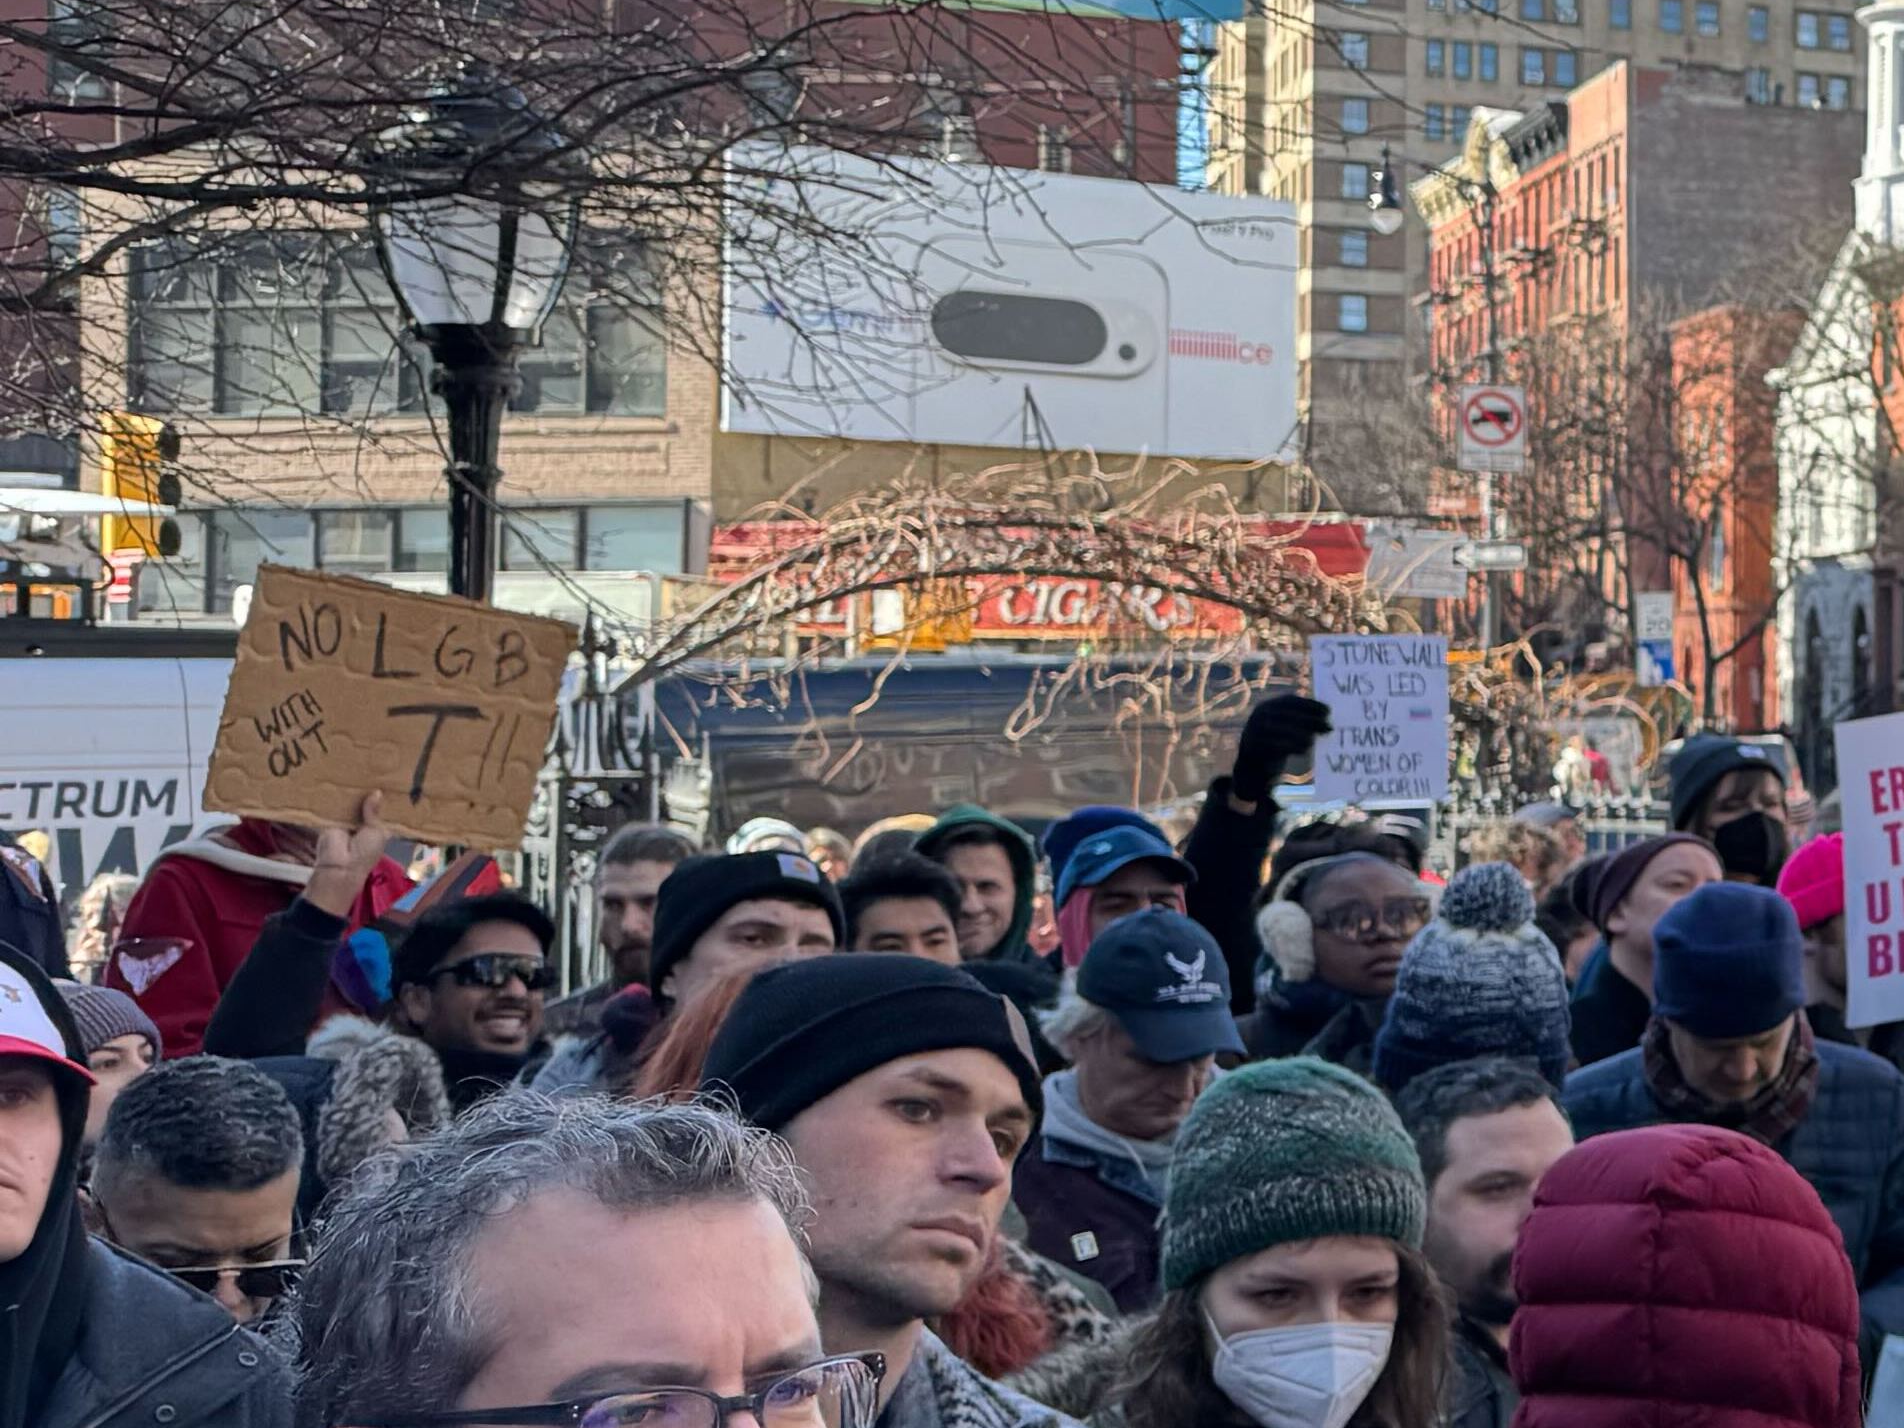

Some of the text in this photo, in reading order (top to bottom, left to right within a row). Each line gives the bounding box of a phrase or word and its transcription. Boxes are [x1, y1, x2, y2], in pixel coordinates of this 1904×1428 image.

[280, 603, 342, 671] NO
[1320, 640, 1446, 669] STONEWALL
[1332, 672, 1427, 697] WAS LED
[254, 688, 323, 743] WITH
[1362, 699, 1389, 722] BY
[268, 721, 328, 777] OUT
[1337, 725, 1400, 748] TRANS
[1327, 751, 1424, 776] WOMEN OF
[1866, 882, 1890, 924] U
